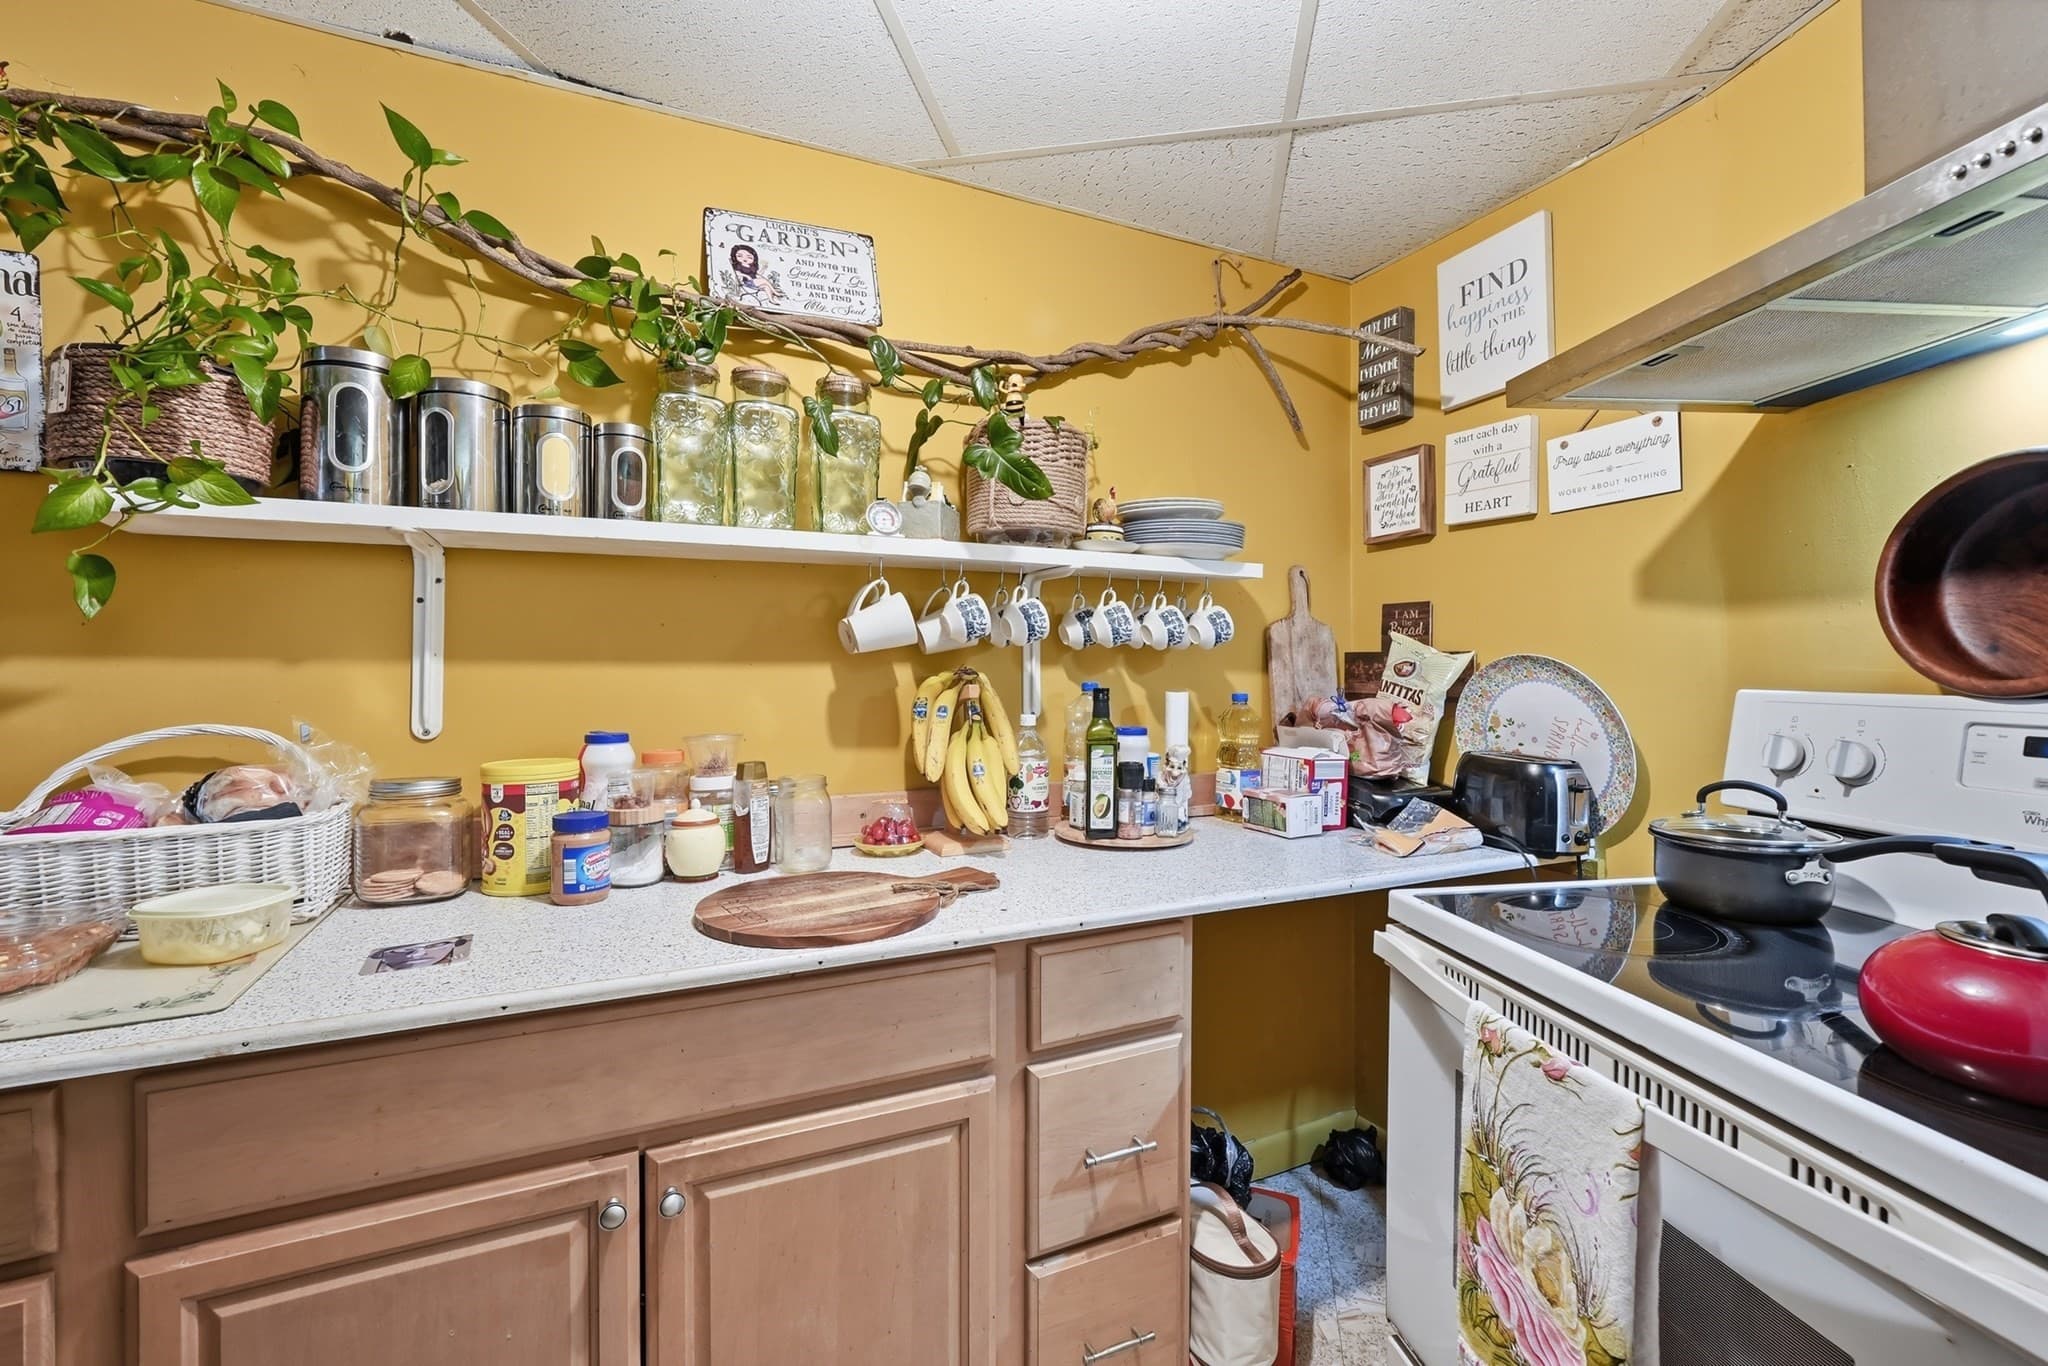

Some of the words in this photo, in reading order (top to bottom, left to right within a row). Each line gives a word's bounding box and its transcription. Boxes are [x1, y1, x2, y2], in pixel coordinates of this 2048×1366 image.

[726, 223, 858, 257] GARDEN
[765, 221, 819, 237] LUCIANE'S
[787, 266, 827, 280] Garden
[795, 259, 813, 267] AND
[818, 261, 838, 271] INTO
[842, 265, 858, 274] THE
[805, 282, 825, 292] LOSE
[828, 286, 841, 295] MY
[844, 289, 867, 298] MIND
[1459, 258, 1528, 309] FIND
[809, 291, 828, 300] AND
[831, 294, 851, 303] FIND
[1447, 285, 1533, 337] happiness
[1488, 317, 1499, 329] IN
[1500, 305, 1526, 322] THE
[1446, 342, 1477, 376] little
[1480, 329, 1537, 361] things
[1360, 356, 1399, 382] EVERYONE
[1360, 404, 1380, 422] THEY
[1382, 399, 1399, 415] HAD
[1453, 433, 1474, 445] start
[1476, 426, 1498, 440] each
[1501, 423, 1520, 434] day
[1473, 443, 1494, 456] with
[1497, 443, 1502, 451] a
[1553, 455, 1581, 470] Pray
[1584, 446, 1612, 463] about
[1615, 434, 1672, 455] everything
[1457, 452, 1521, 496] Grateful
[1558, 486, 1587, 497] WORRY
[1592, 479, 1620, 490] ABOUT
[1624, 469, 1667, 484] NOTHING
[1374, 490, 1418, 511] wonderful
[1464, 495, 1512, 513] HEART
[1380, 509, 1394, 522] joy
[1396, 505, 1416, 519] ahead
[1402, 609, 1419, 619] AM
[1389, 621, 1425, 636] Bread
[1567, 717, 1592, 755] hello
